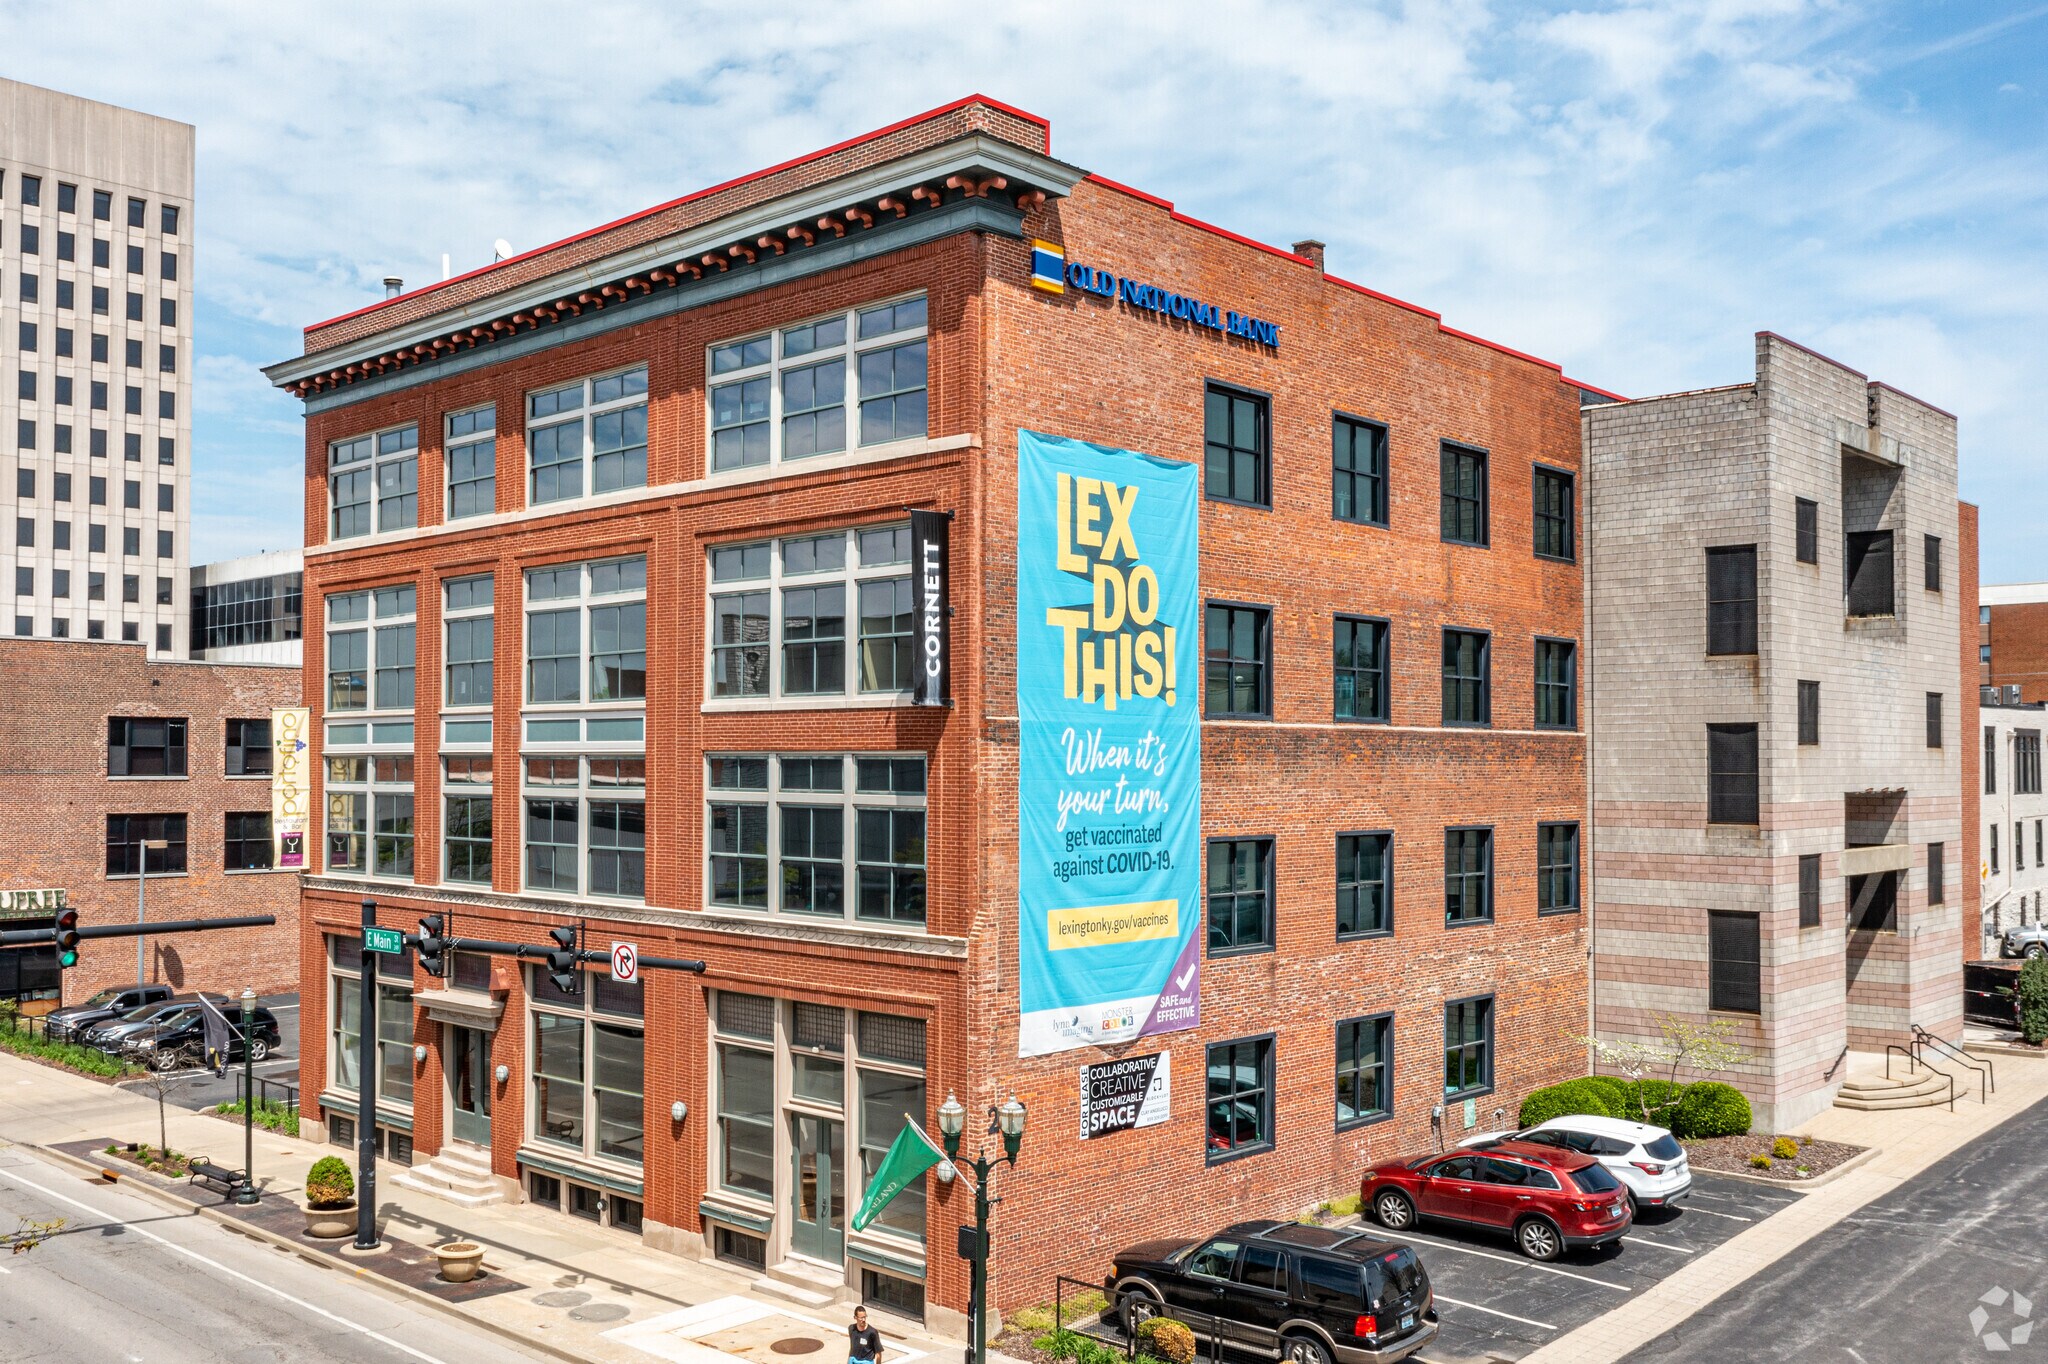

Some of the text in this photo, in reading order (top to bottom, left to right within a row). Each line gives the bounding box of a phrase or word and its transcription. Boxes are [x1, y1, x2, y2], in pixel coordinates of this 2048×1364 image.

[1067, 262, 1281, 347] OLD NATIONAL BANK
[1056, 472, 1140, 573] LEX
[924, 539, 941, 677] CORNETT
[1093, 563, 1160, 633] DO
[1046, 607, 1177, 711] THIS!
[1060, 727, 1132, 776] When
[1056, 773, 1169, 832] your turn,
[1065, 821, 1163, 853] get vaccinated
[1053, 849, 1175, 883] against COVID-19.
[367, 931, 373, 947] E
[373, 932, 392, 950] Main
[1058, 912, 1169, 938] lexingtonky.gov/vaccines
[1101, 1006, 1133, 1020] MONSTER
[1156, 1005, 1195, 1023] EFFECTIVE
[1160, 991, 1193, 1009] SAFE and
[1090, 1057, 1156, 1080] COLLABORATIVE
[1090, 1072, 1146, 1099] CREATIVE
[1090, 1091, 1144, 1111] CUSTOMIZABLE
[1081, 1067, 1089, 1137] FOR LEASE
[1090, 1104, 1136, 1132] SPACE
